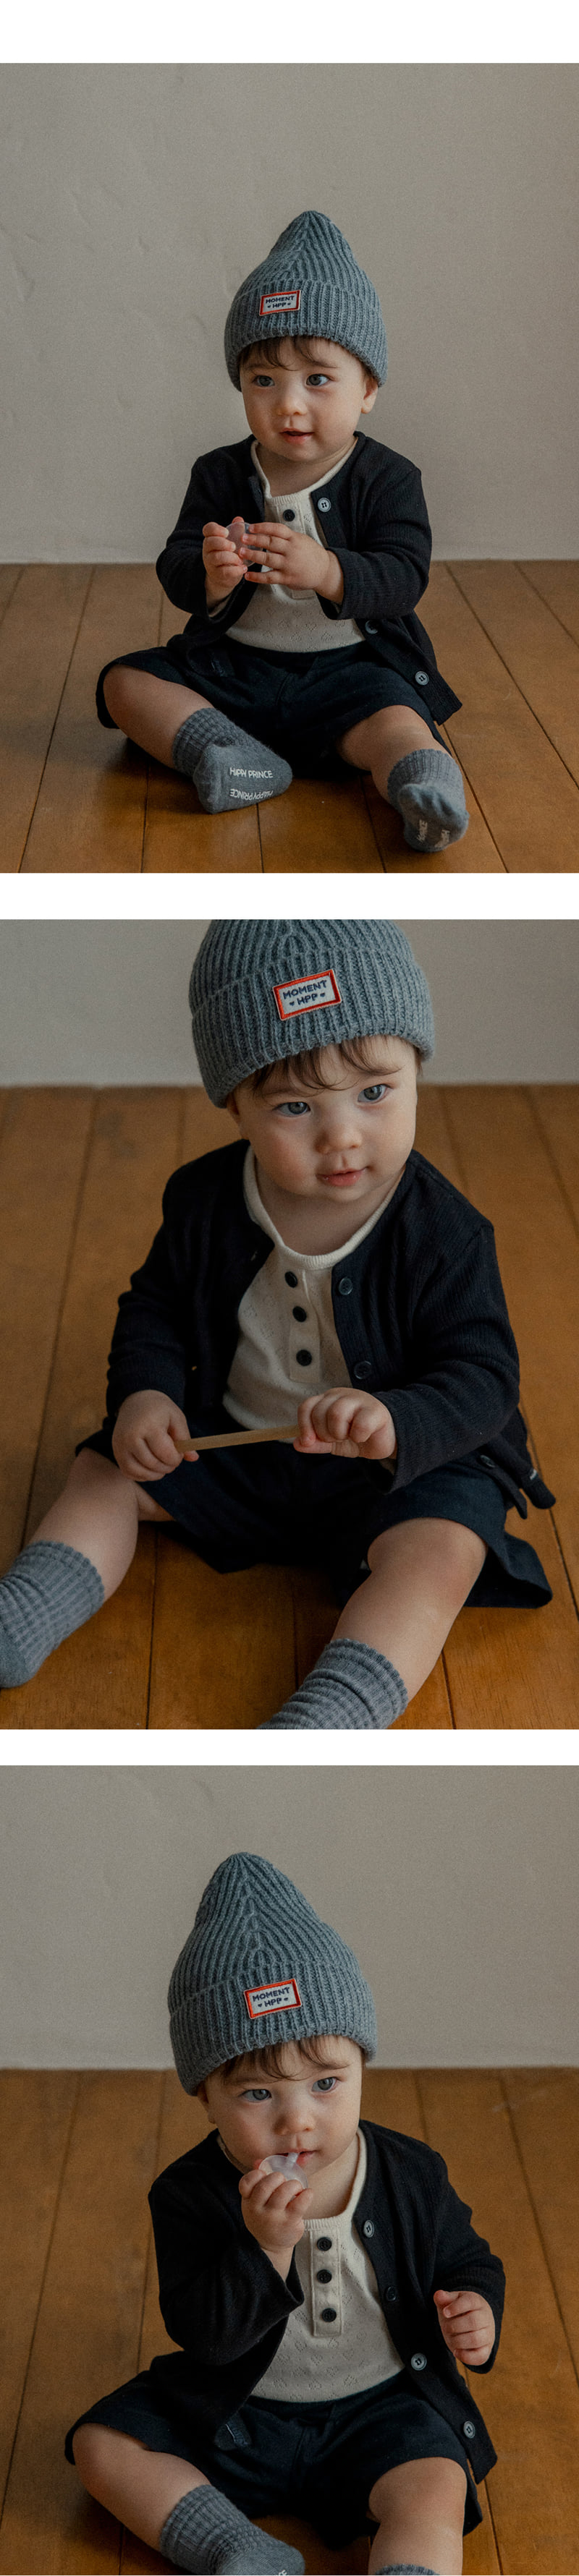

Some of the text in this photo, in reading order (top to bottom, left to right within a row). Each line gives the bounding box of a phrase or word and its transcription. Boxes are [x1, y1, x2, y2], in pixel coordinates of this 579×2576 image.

[266, 295, 295, 304] MOMENT
[248, 769, 274, 779] PRINCE
[230, 788, 253, 801] PRINCE
[282, 979, 327, 999] MOMENT
[297, 993, 318, 1005] HPP
[252, 1987, 290, 2003] MOMENT
[264, 1997, 282, 2007] HPP
